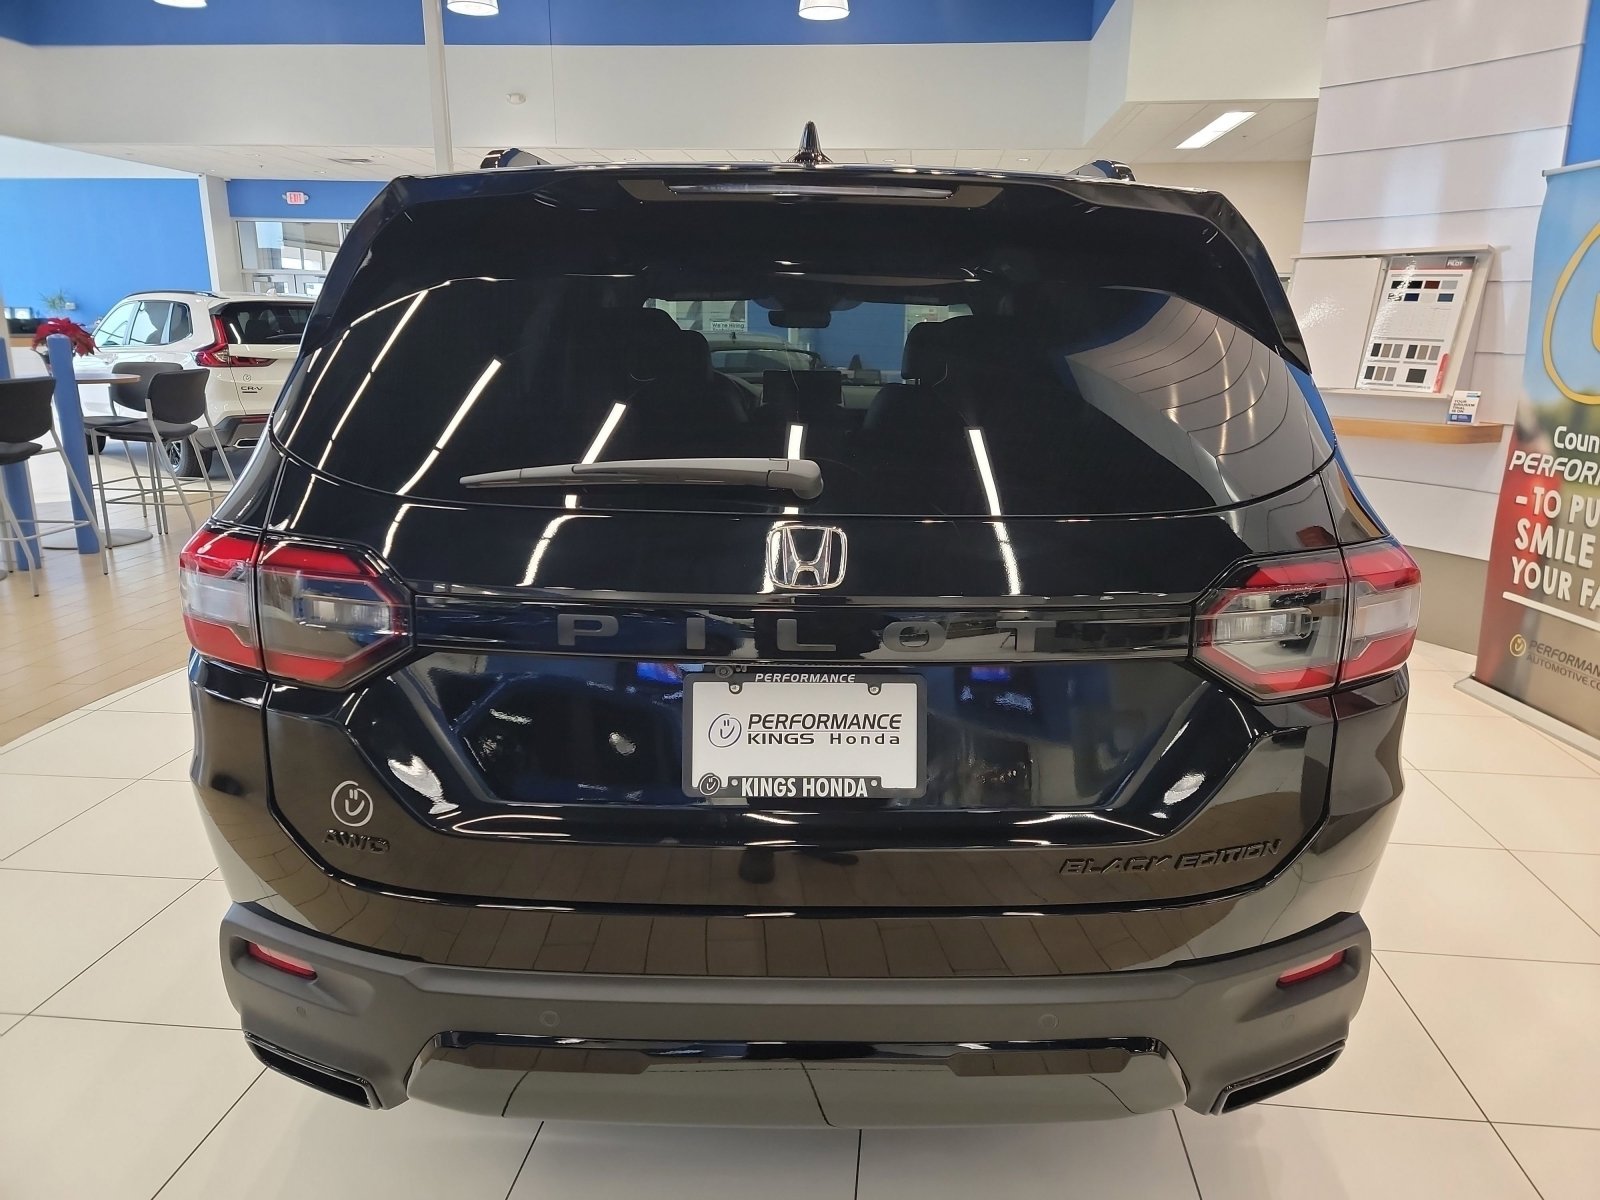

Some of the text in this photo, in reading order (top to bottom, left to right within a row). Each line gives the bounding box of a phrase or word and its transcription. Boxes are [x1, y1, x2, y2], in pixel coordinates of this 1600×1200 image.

[289, 193, 302, 203] EXIT
[1553, 426, 1600, 454] Coun
[1508, 450, 1600, 486] PERFOR
[1514, 518, 1596, 568] SMILE
[1512, 556, 1572, 600] YOUR
[556, 613, 1056, 653] PILOT
[754, 673, 856, 683] PERFORMANCE
[747, 713, 902, 730] PERFORMANCE
[747, 733, 900, 745] KINGS Honda
[741, 778, 868, 797] KINGS HONDA
[322, 829, 390, 854] AWD
[1059, 838, 1282, 875] BLACK EDITION
